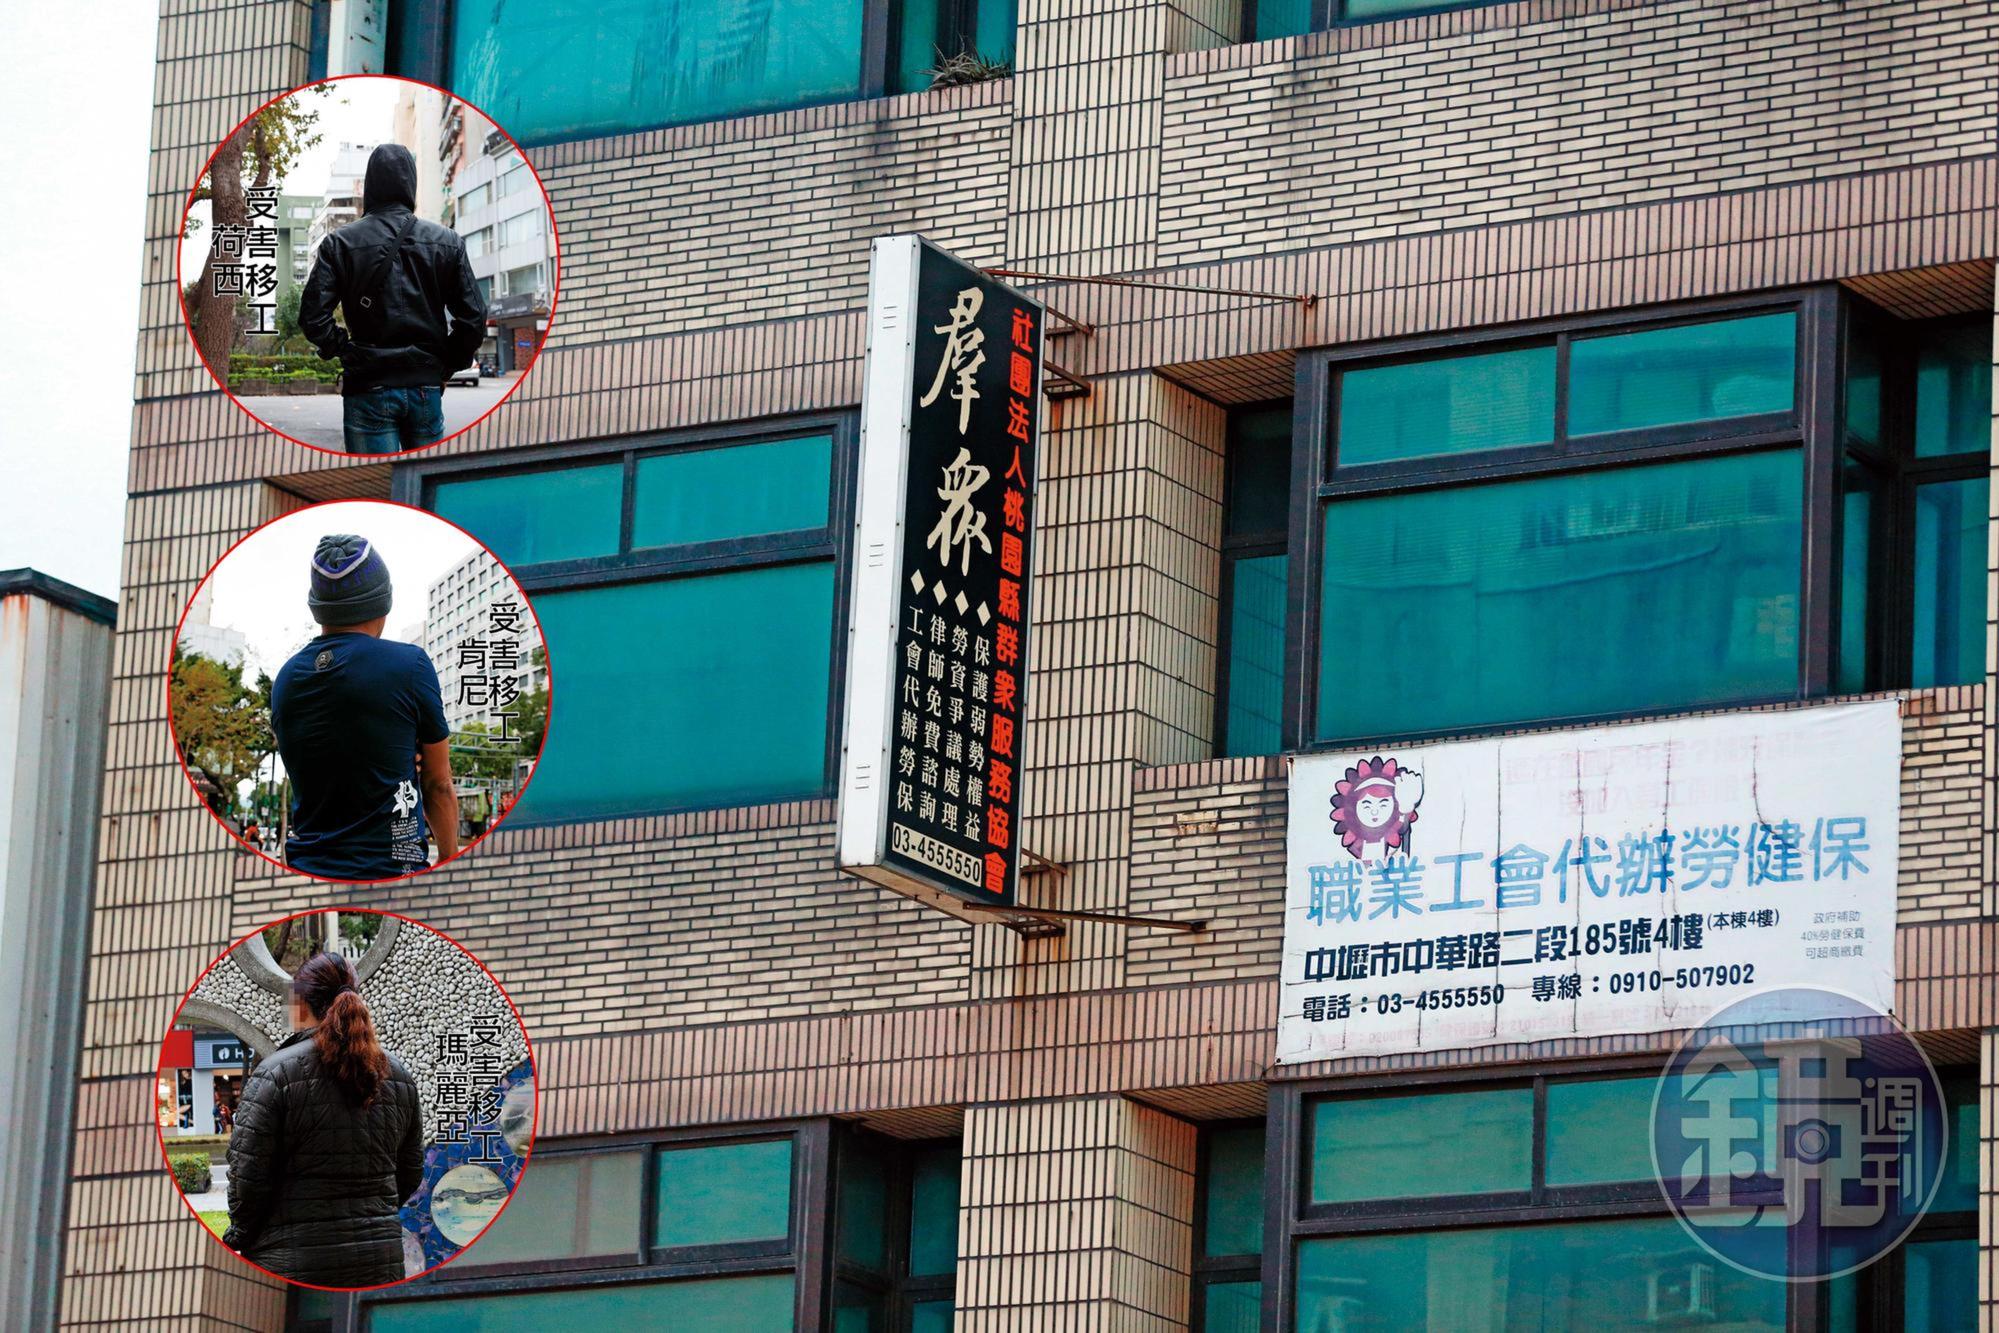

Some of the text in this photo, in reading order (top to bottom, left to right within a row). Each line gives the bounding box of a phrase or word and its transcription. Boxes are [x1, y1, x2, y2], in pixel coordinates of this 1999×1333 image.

[896, 605, 925, 814] 工會代辦勞保
[919, 612, 947, 824] 律師免費諮詢
[941, 624, 969, 834] 勞資爭議處理
[963, 634, 991, 843] 保護弱勢權益
[892, 827, 981, 883] 03-4555550
[1303, 913, 1704, 983] 中壢市中華路二段185號4樓
[1305, 816, 1872, 927] 職業工會代辦勞健保
